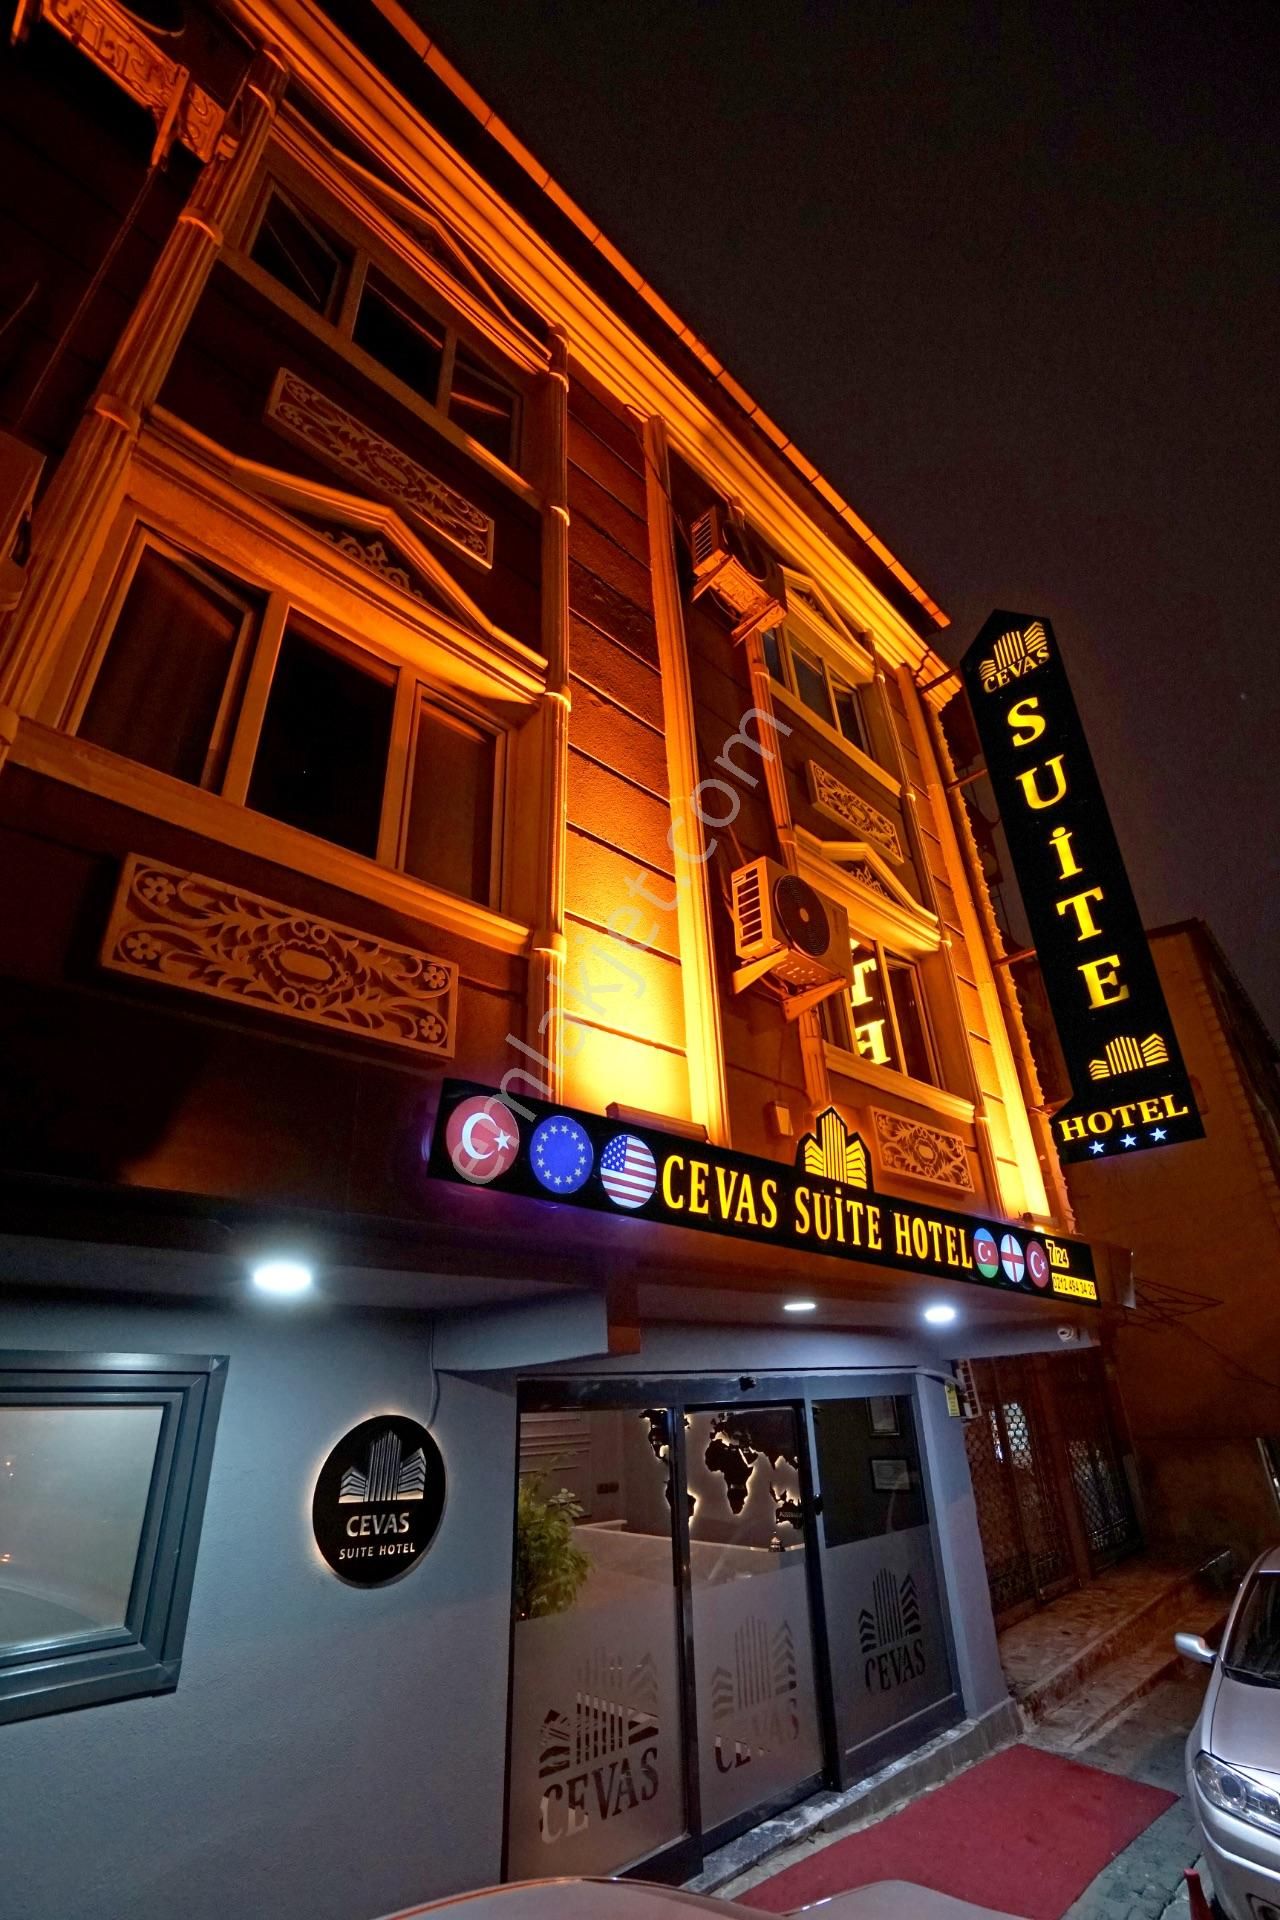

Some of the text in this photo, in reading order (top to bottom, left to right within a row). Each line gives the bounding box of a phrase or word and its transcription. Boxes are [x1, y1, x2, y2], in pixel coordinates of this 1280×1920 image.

[983, 646, 1050, 693] CEVAS
[1058, 1094, 1188, 1141] HOTEL
[662, 1155, 778, 1229] CEVAS
[894, 1212, 973, 1269] HOTEL
[346, 1512, 410, 1537] CEVAS
[338, 1542, 416, 1560] SUITE HOTEL
[865, 1639, 926, 1692] CEVAS
[540, 1747, 659, 1844] CEVAS
